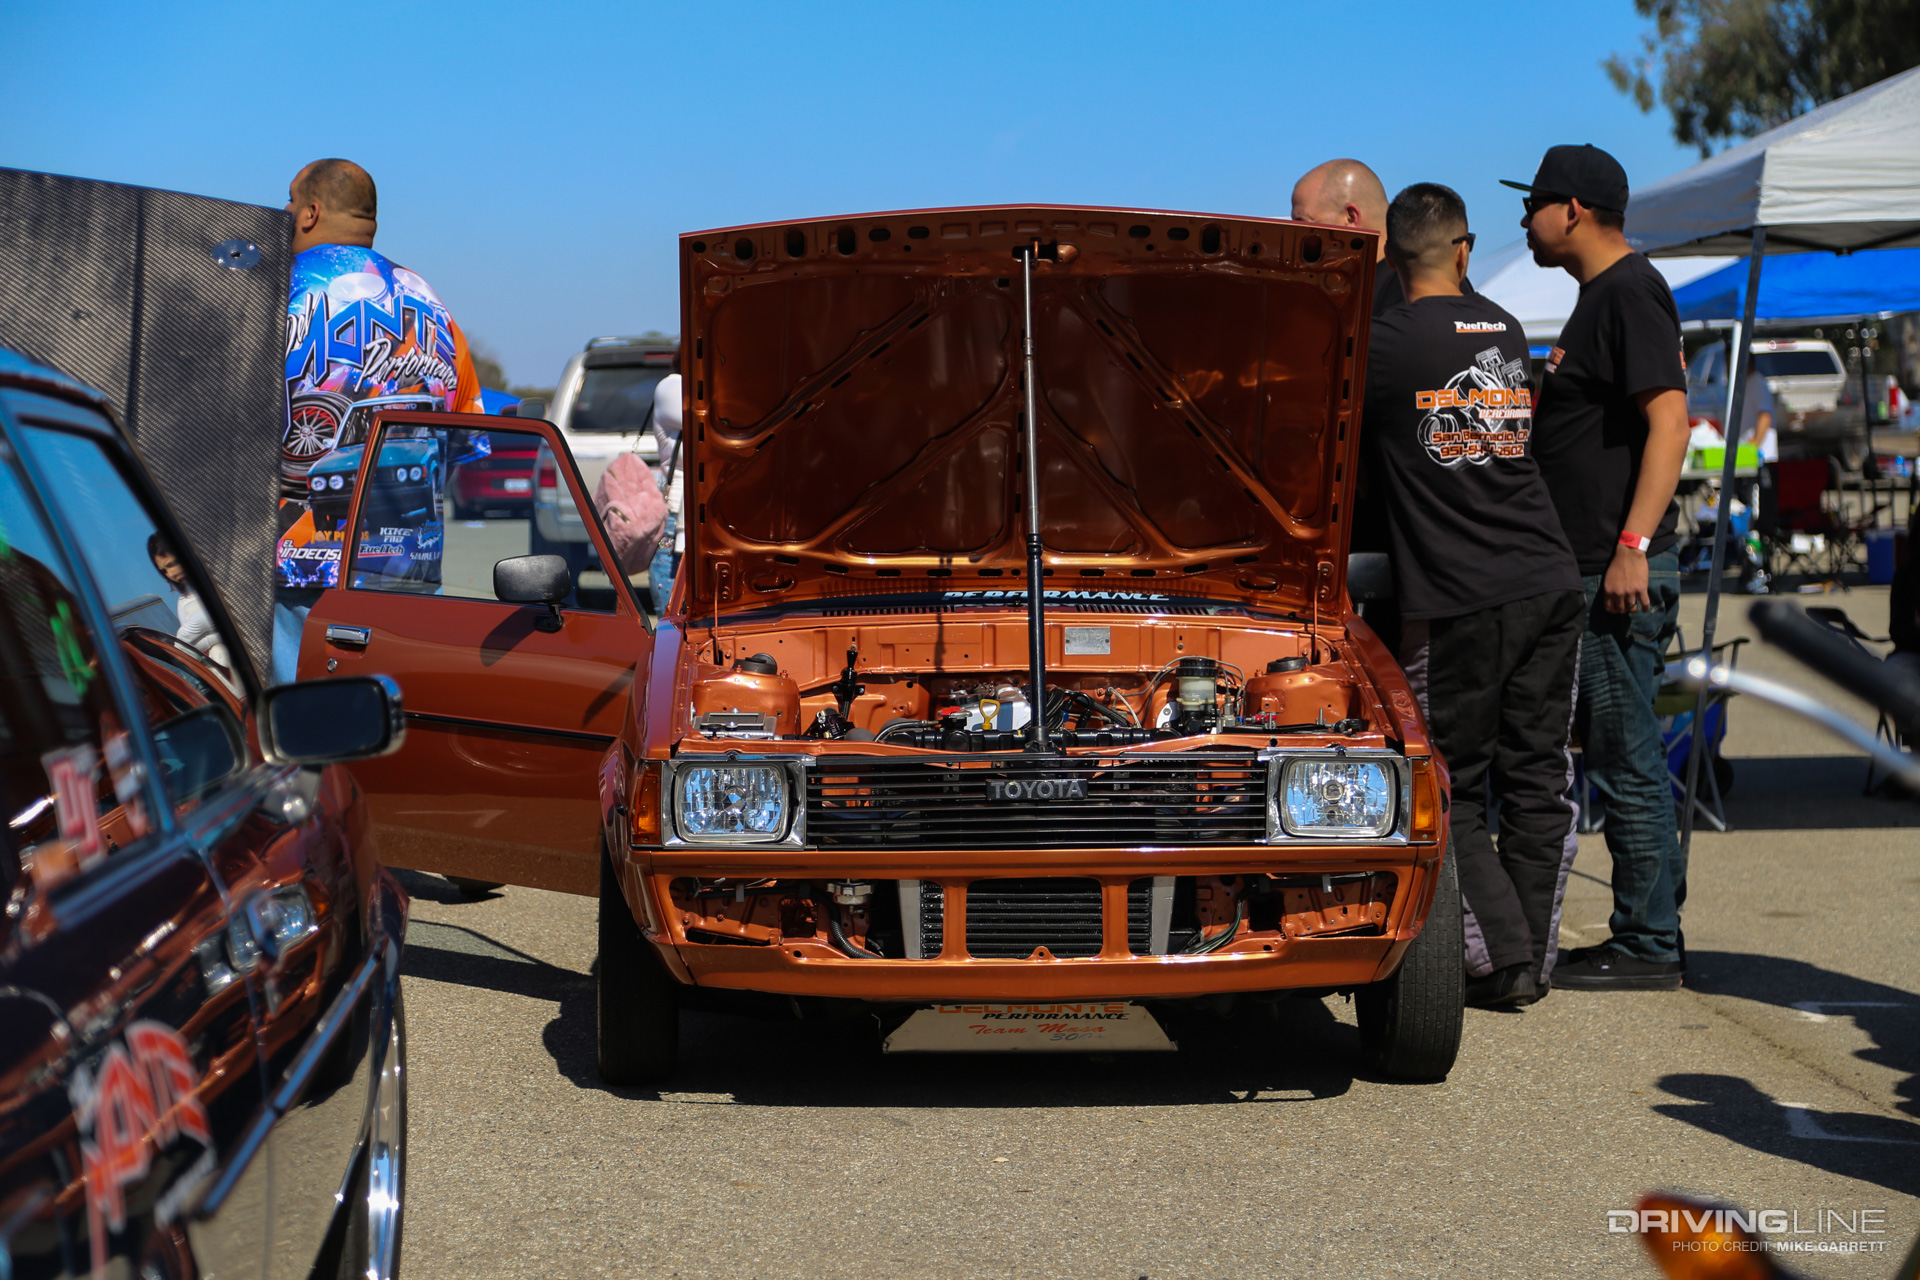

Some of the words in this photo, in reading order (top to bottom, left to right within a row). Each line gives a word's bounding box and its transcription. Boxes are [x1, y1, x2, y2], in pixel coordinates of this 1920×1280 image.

[1454, 321, 1507, 333] FuelTech
[990, 781, 1084, 798] TOYOTA
[968, 1024, 1028, 1035] Team
